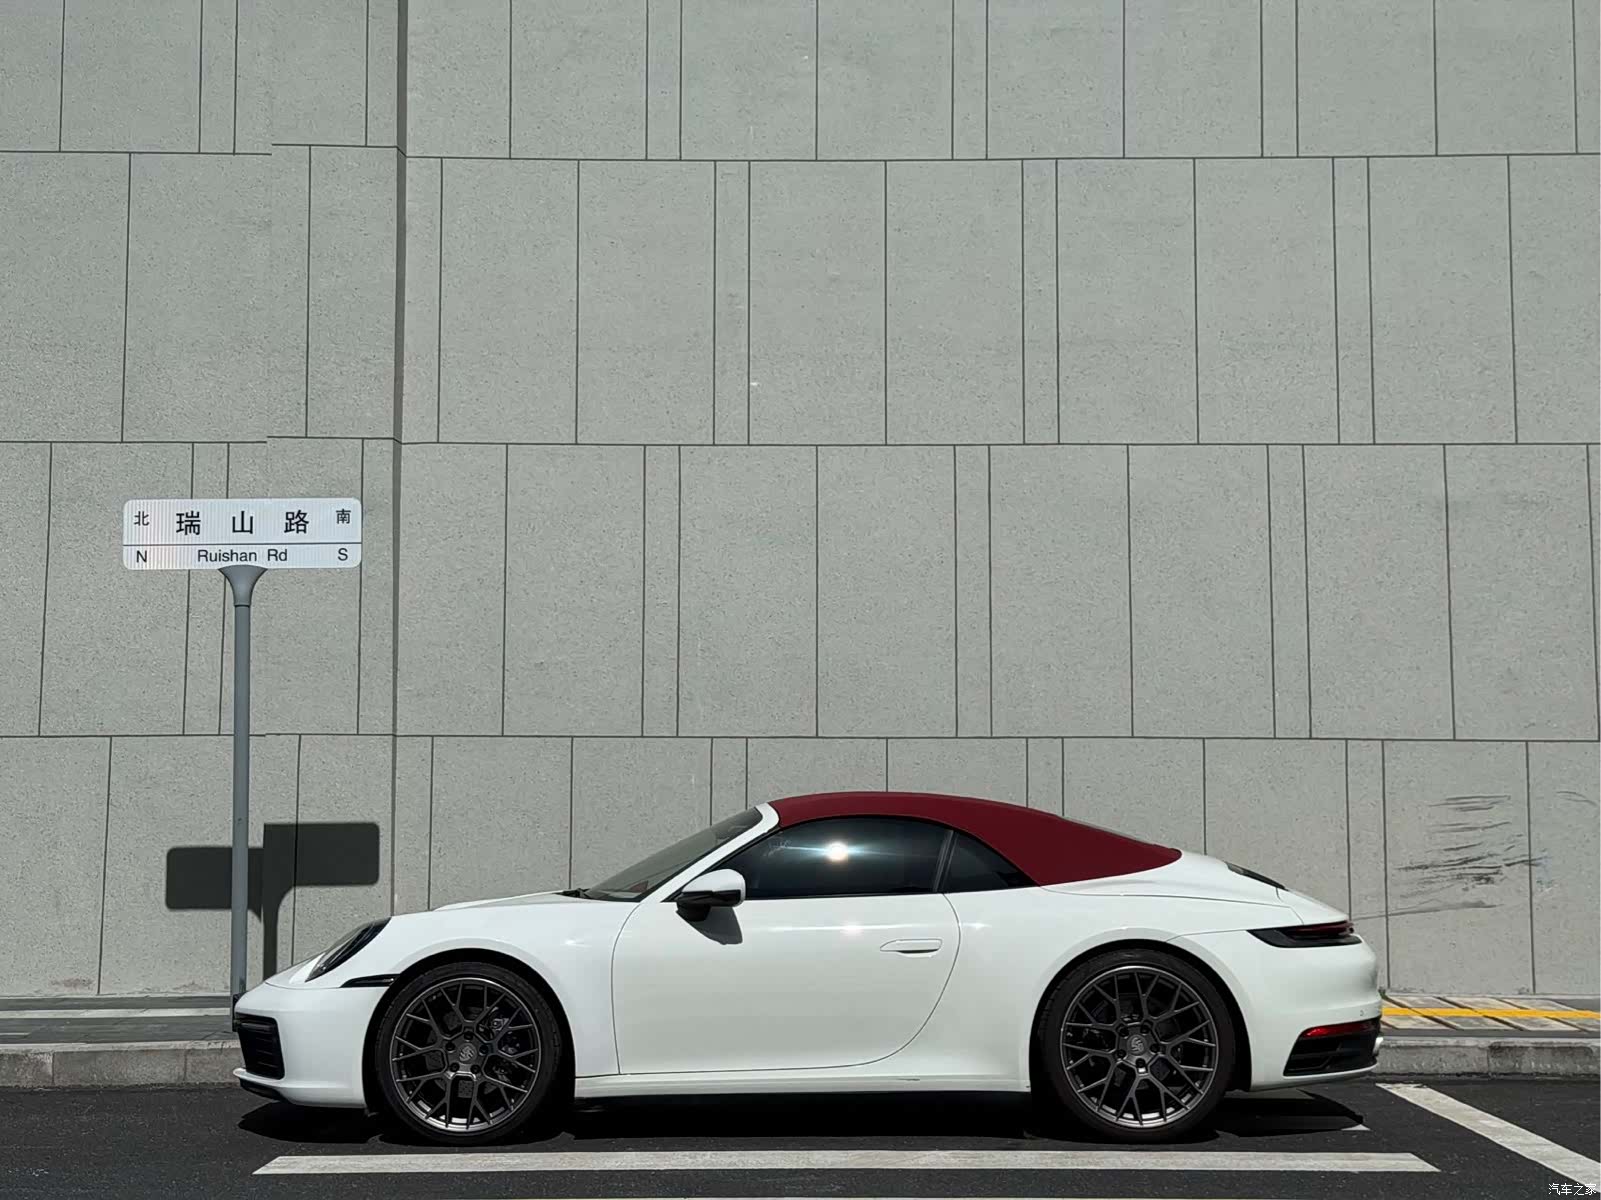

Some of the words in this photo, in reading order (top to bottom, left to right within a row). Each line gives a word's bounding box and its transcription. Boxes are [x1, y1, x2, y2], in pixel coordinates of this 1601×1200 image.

[134, 510, 150, 526] 北
[175, 509, 310, 536] 瑞山路
[335, 508, 352, 524] 南
[136, 550, 148, 563] N
[197, 549, 257, 562] Ruishan
[267, 548, 288, 562] Rd
[337, 547, 349, 561] S
